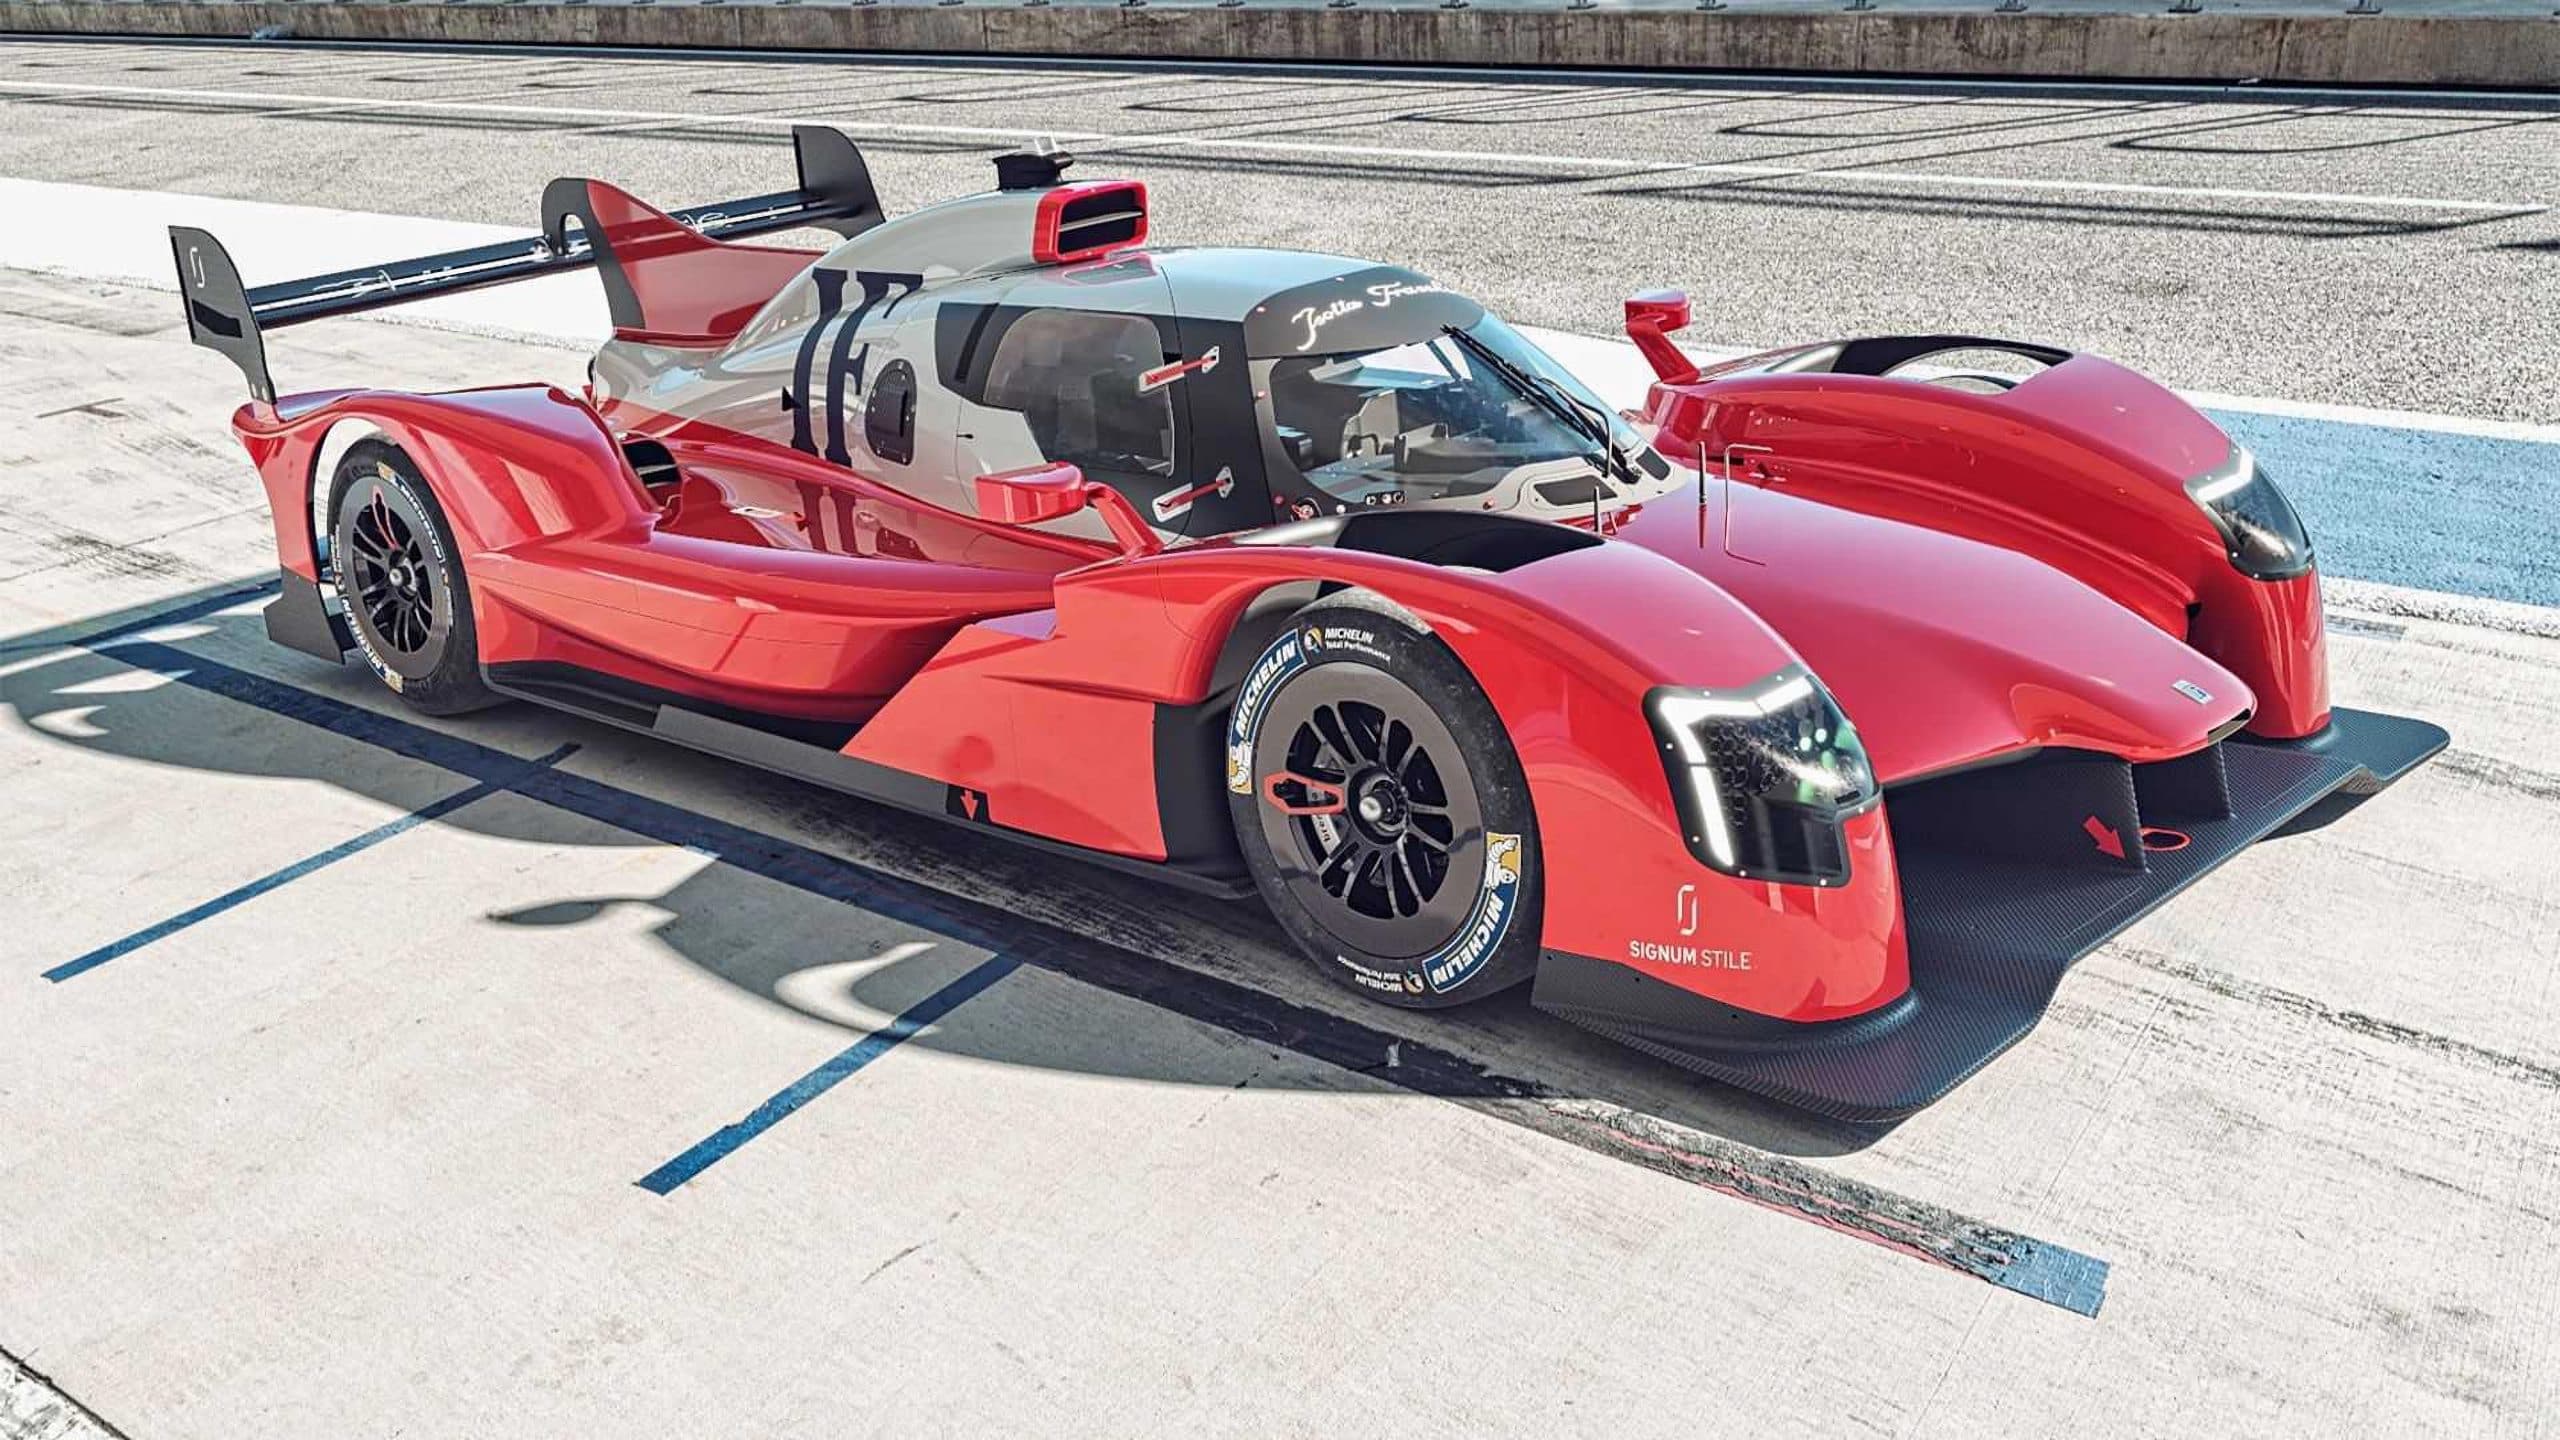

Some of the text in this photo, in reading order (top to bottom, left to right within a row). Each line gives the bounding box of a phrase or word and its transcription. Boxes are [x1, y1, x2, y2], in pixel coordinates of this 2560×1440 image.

[1325, 627, 1374, 643] MICHELIN
[1235, 640, 1296, 738] MICHELIN
[1431, 892, 1504, 985] MICHELIN
[1629, 939, 1752, 970] SIGNUM STILE
